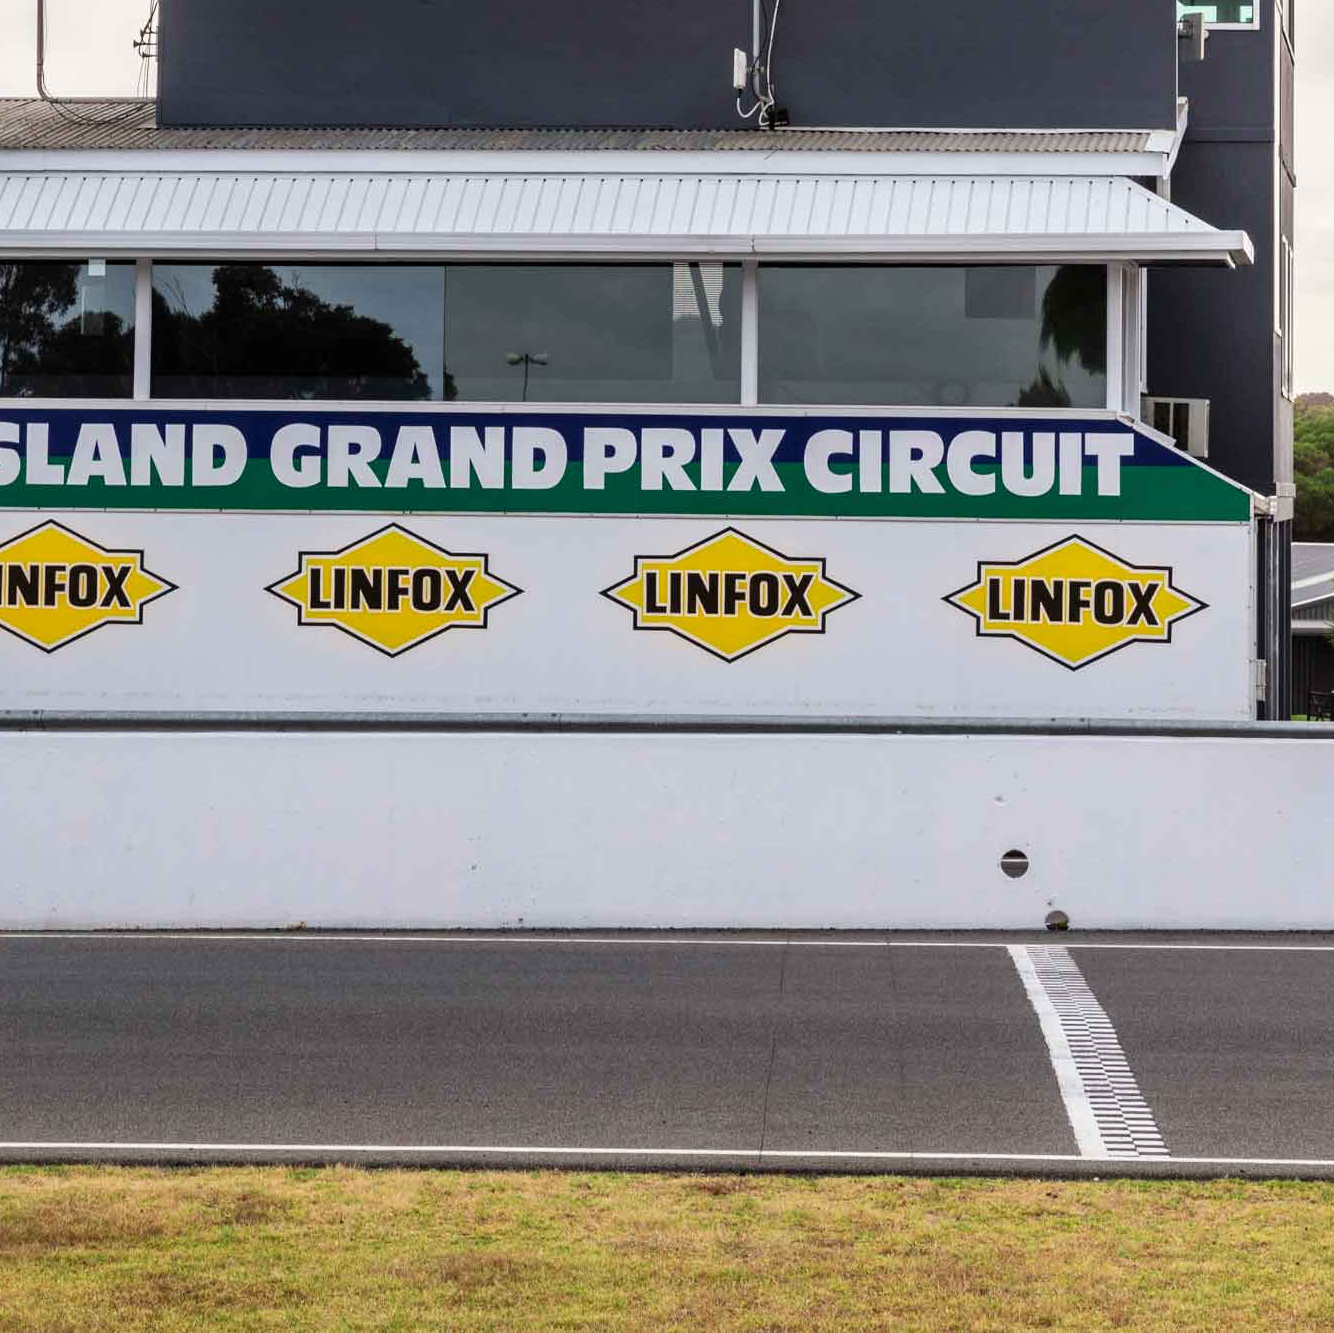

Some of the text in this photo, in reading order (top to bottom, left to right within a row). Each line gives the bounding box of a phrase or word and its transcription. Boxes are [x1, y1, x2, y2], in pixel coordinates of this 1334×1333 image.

[270, 423, 568, 490] GRAND
[583, 427, 786, 492] PRIX
[803, 429, 1135, 497] CIRCUIT
[310, 568, 477, 612] LINFOX
[646, 572, 815, 617] LINFOX
[989, 578, 1160, 626] LINFOX
